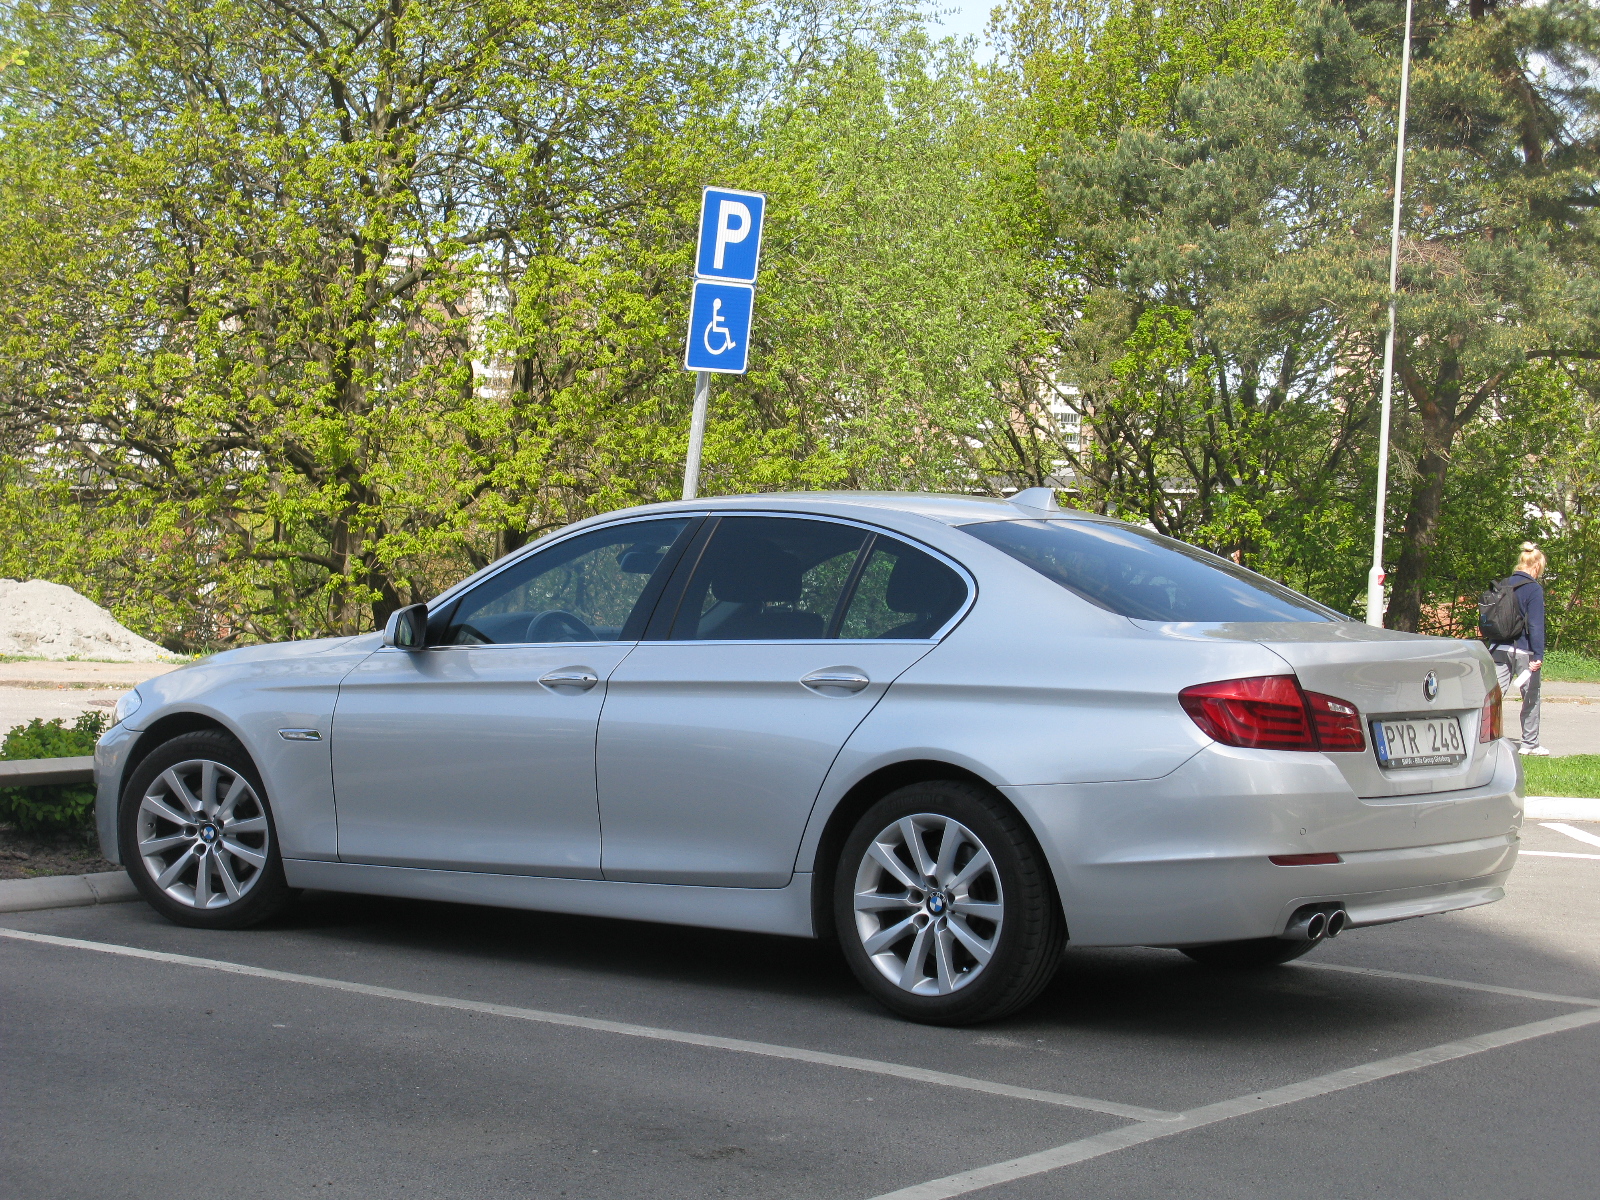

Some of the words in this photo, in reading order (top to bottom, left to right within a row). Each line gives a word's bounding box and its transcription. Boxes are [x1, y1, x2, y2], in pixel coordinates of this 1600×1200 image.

[713, 199, 752, 270] P
[1384, 724, 1421, 756] PYR
[1427, 722, 1460, 752] 248
